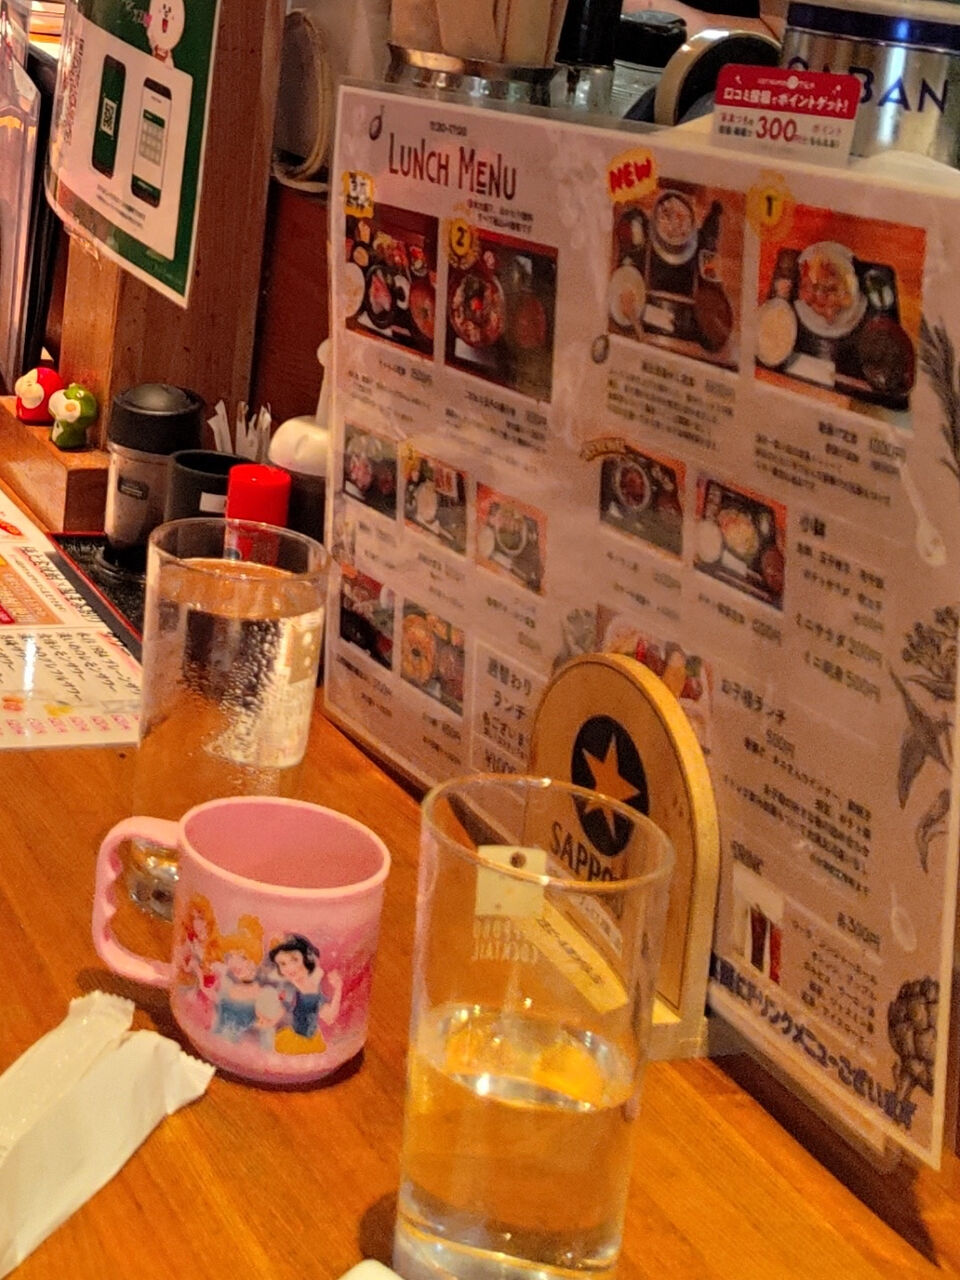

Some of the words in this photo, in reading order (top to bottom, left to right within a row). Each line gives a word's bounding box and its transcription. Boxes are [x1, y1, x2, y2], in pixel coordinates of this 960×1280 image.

[755, 115, 797, 142] 300
[388, 132, 448, 187] LUNCH
[458, 146, 516, 202] MENU
[609, 157, 653, 194] NEW
[456, 225, 466, 248] 2
[492, 687, 526, 725] ランチ
